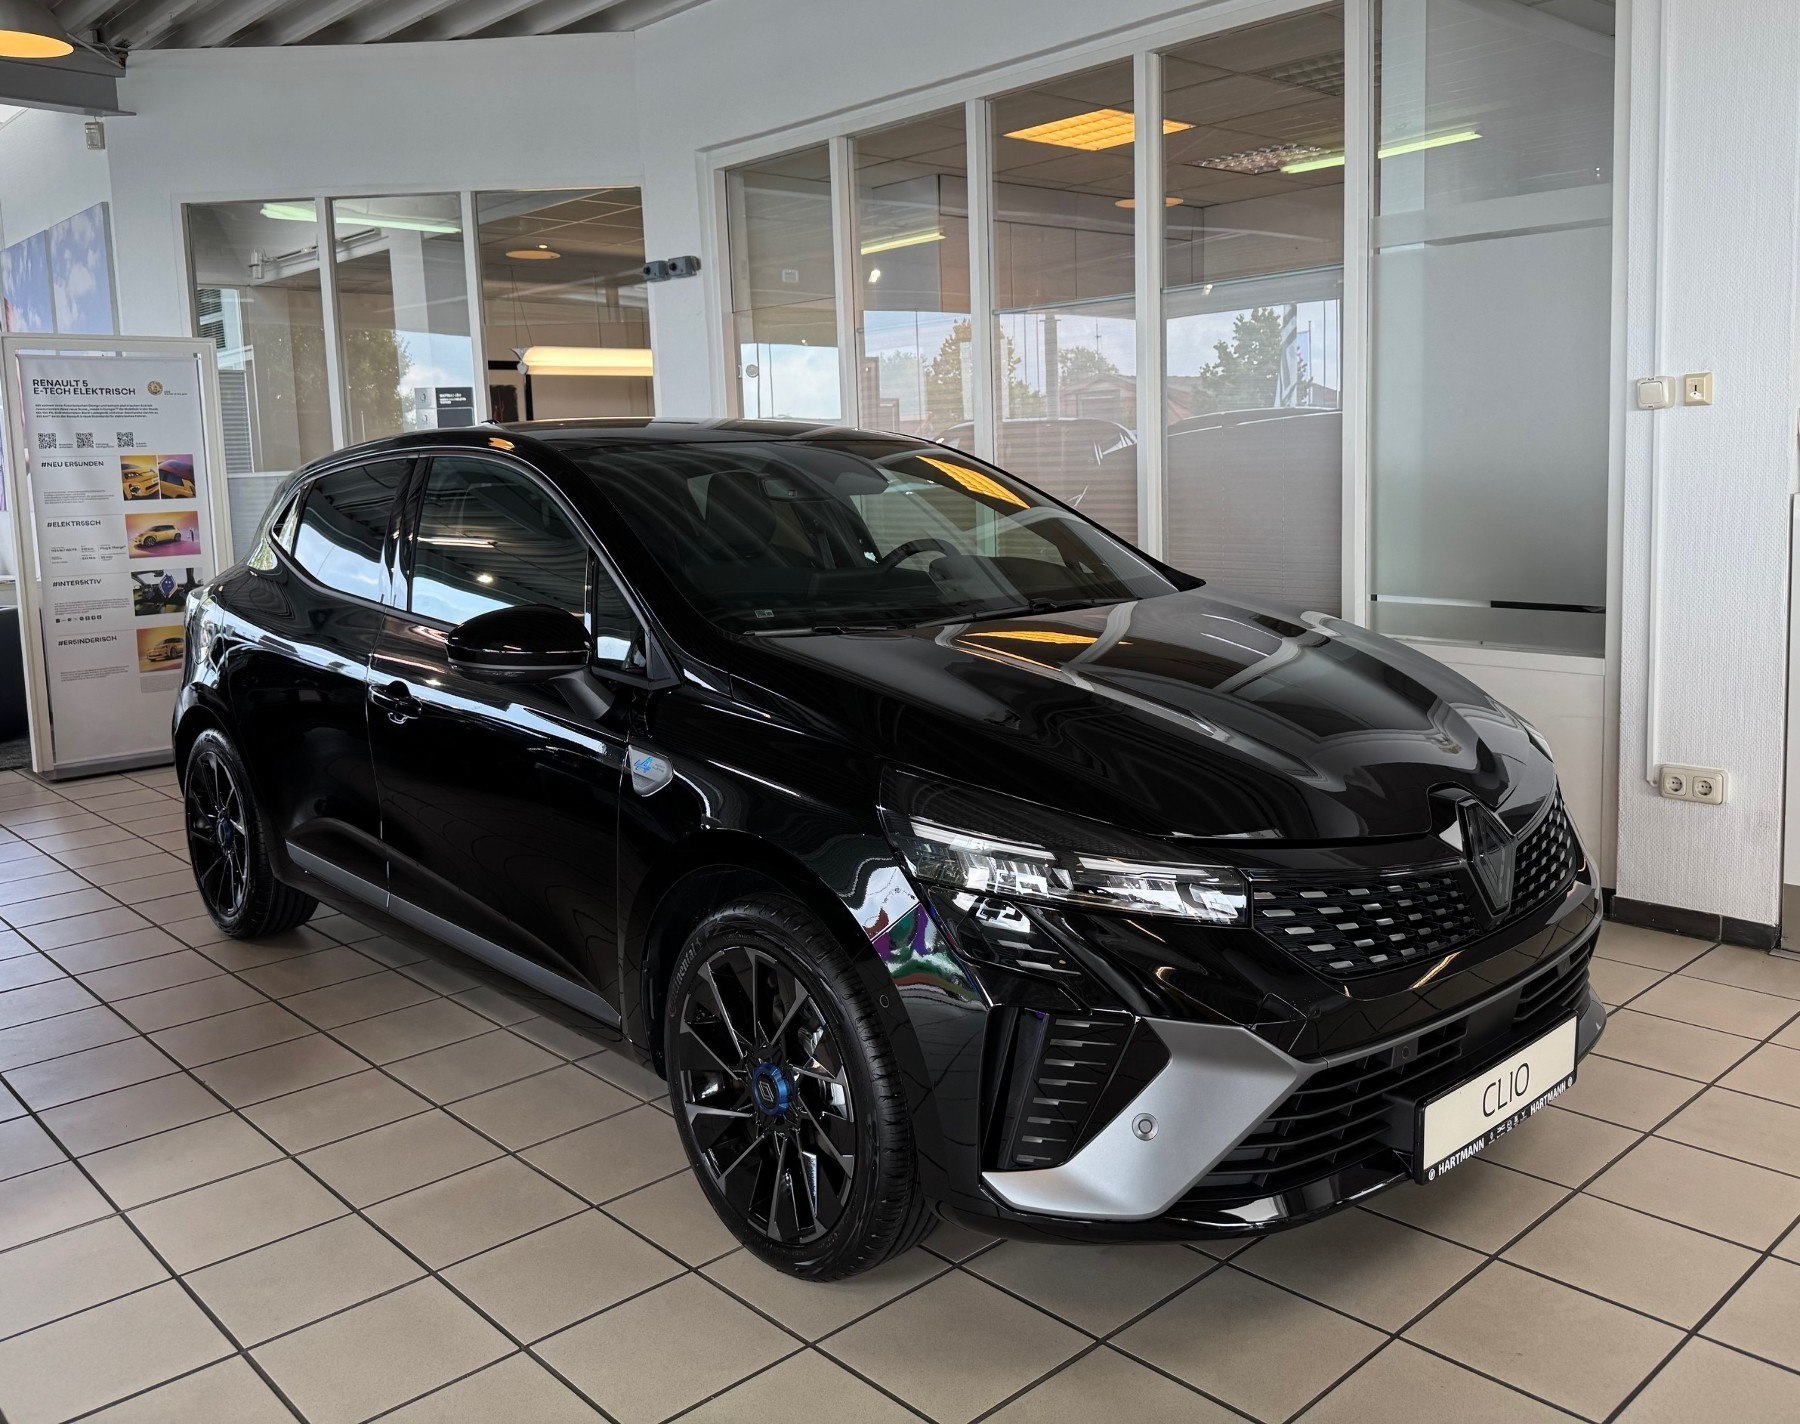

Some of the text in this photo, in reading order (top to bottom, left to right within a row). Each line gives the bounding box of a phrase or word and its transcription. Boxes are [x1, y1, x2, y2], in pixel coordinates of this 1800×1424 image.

[32, 379, 88, 388] RENAULT 5
[33, 387, 136, 396] E-TECH ELEKTRISCH
[1482, 1062, 1530, 1118] CLIO
[1438, 1081, 1566, 1176] HARTMANN HARTMANN
